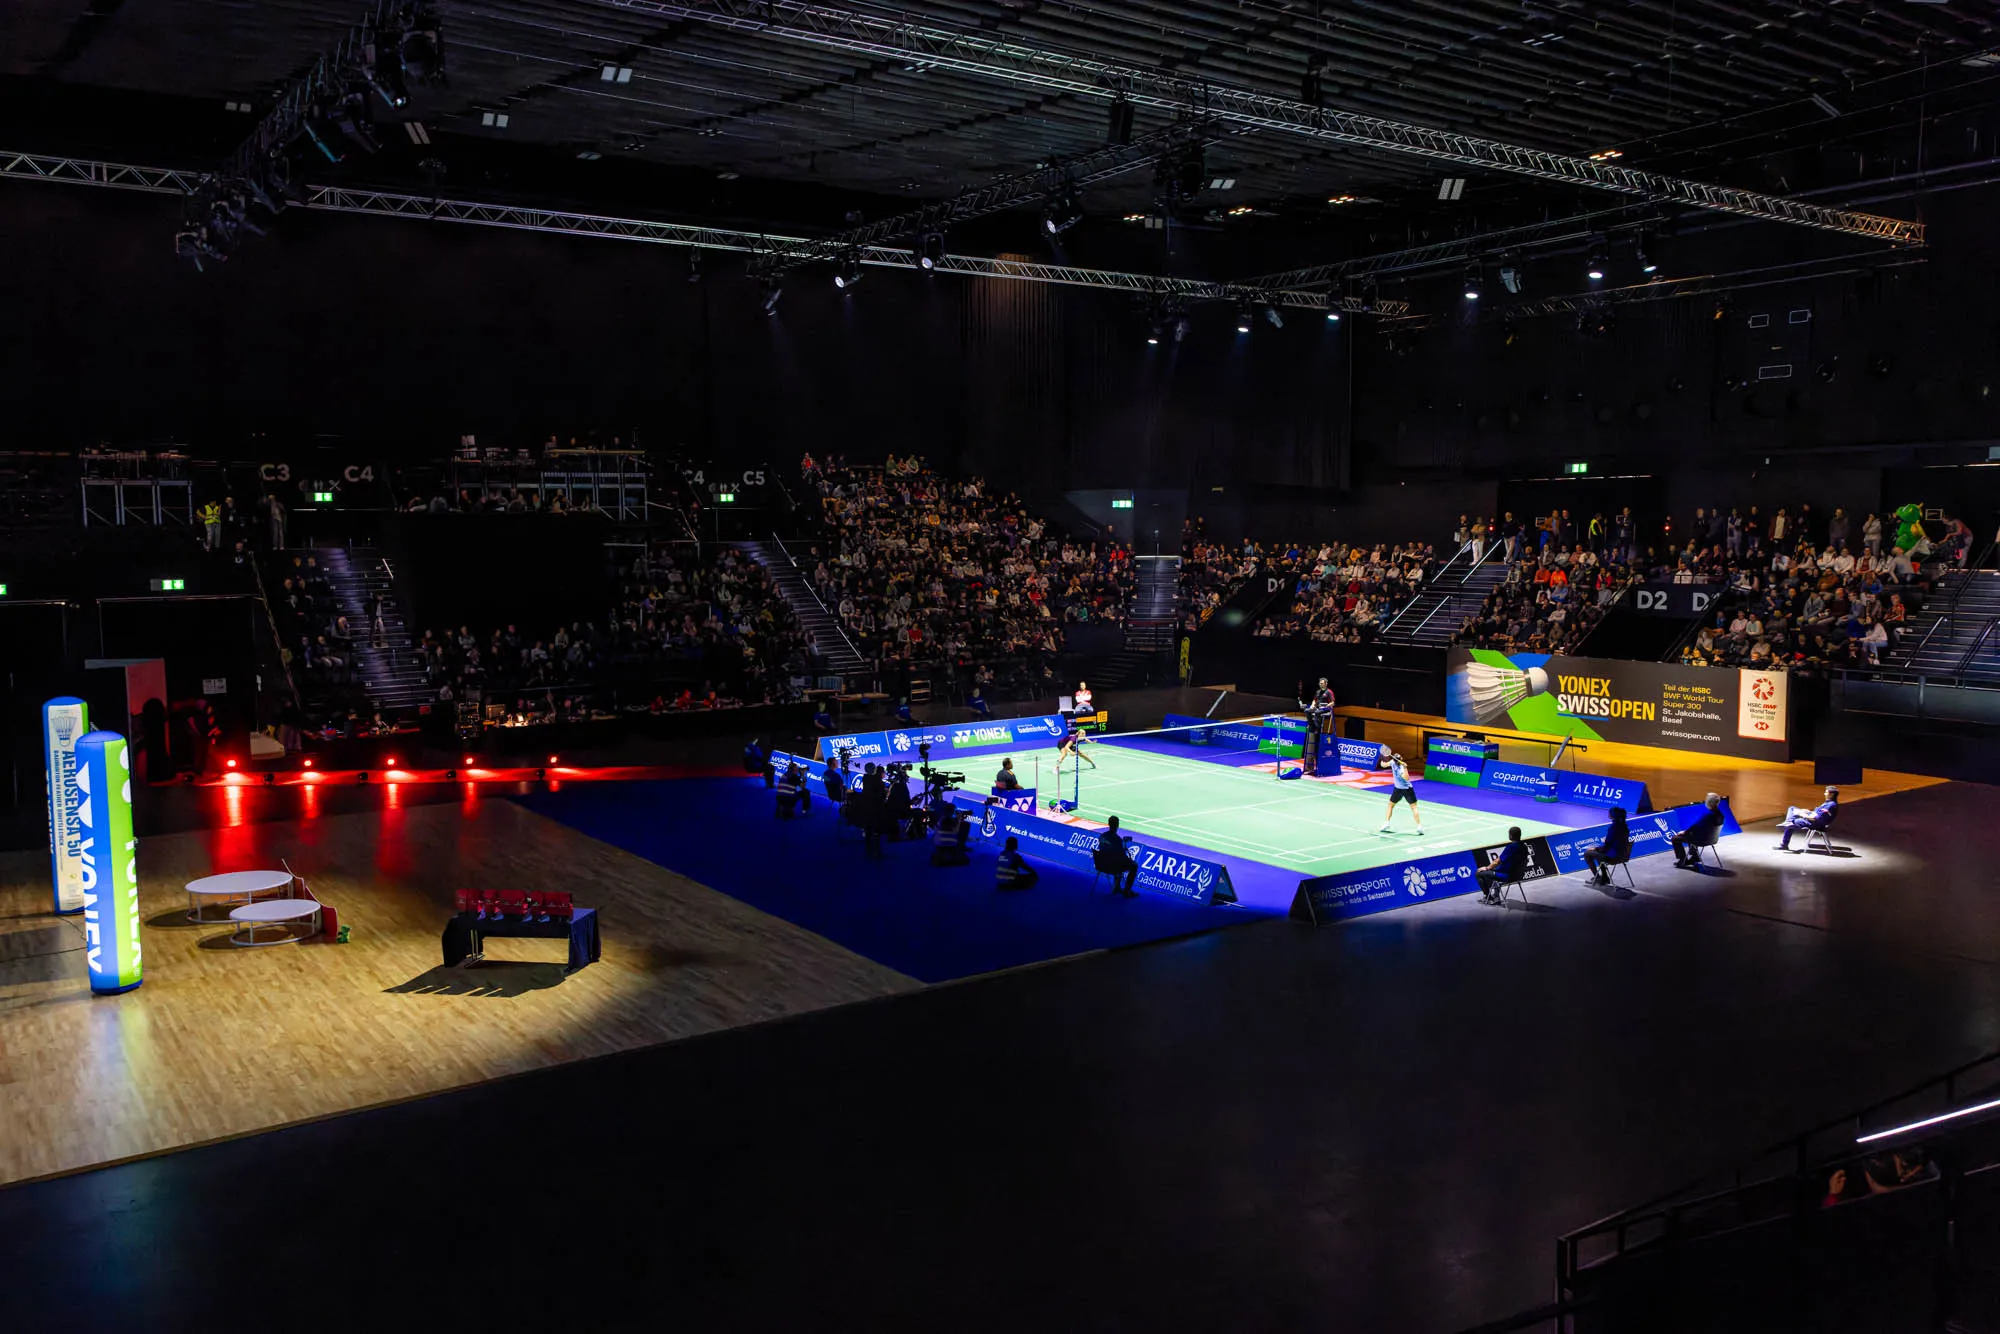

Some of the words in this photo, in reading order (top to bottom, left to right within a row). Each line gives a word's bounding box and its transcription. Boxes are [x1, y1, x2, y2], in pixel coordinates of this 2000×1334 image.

[261, 464, 290, 481] C3
[344, 465, 374, 482] C4
[743, 470, 765, 485] C5
[1637, 590, 1668, 610] D2
[1692, 592, 1720, 611] D
[1558, 674, 1612, 697] YONEX
[1663, 683, 1676, 691] Teil
[1677, 685, 1690, 693] der
[1663, 692, 1681, 700] BWF
[1682, 694, 1705, 702] World
[1708, 696, 1724, 704] Tour
[1663, 700, 1685, 709] Super
[1686, 702, 1702, 710] 300
[1557, 694, 1655, 721] SWISSOPEN
[1662, 716, 1682, 724] Basel
[973, 727, 1008, 742] YONEX
[1661, 729, 1721, 742] swissopen.com
[830, 737, 858, 748] YONEX
[1451, 744, 1472, 754] YONEX
[832, 744, 882, 757] SSSOPEN
[1338, 743, 1378, 758] SWISSLOS
[1448, 765, 1468, 775] YONEX
[1493, 771, 1541, 784] copartner
[62, 750, 80, 836] AERUSENSA
[1573, 782, 1623, 799] ALTIUS
[67, 839, 81, 857] 50
[1141, 851, 1201, 883] ZARAZ
[1425, 870, 1441, 879] HSBC
[1137, 871, 1193, 897] Gastronomie
[1430, 877, 1446, 886] World
[1445, 876, 1457, 884] Tour
